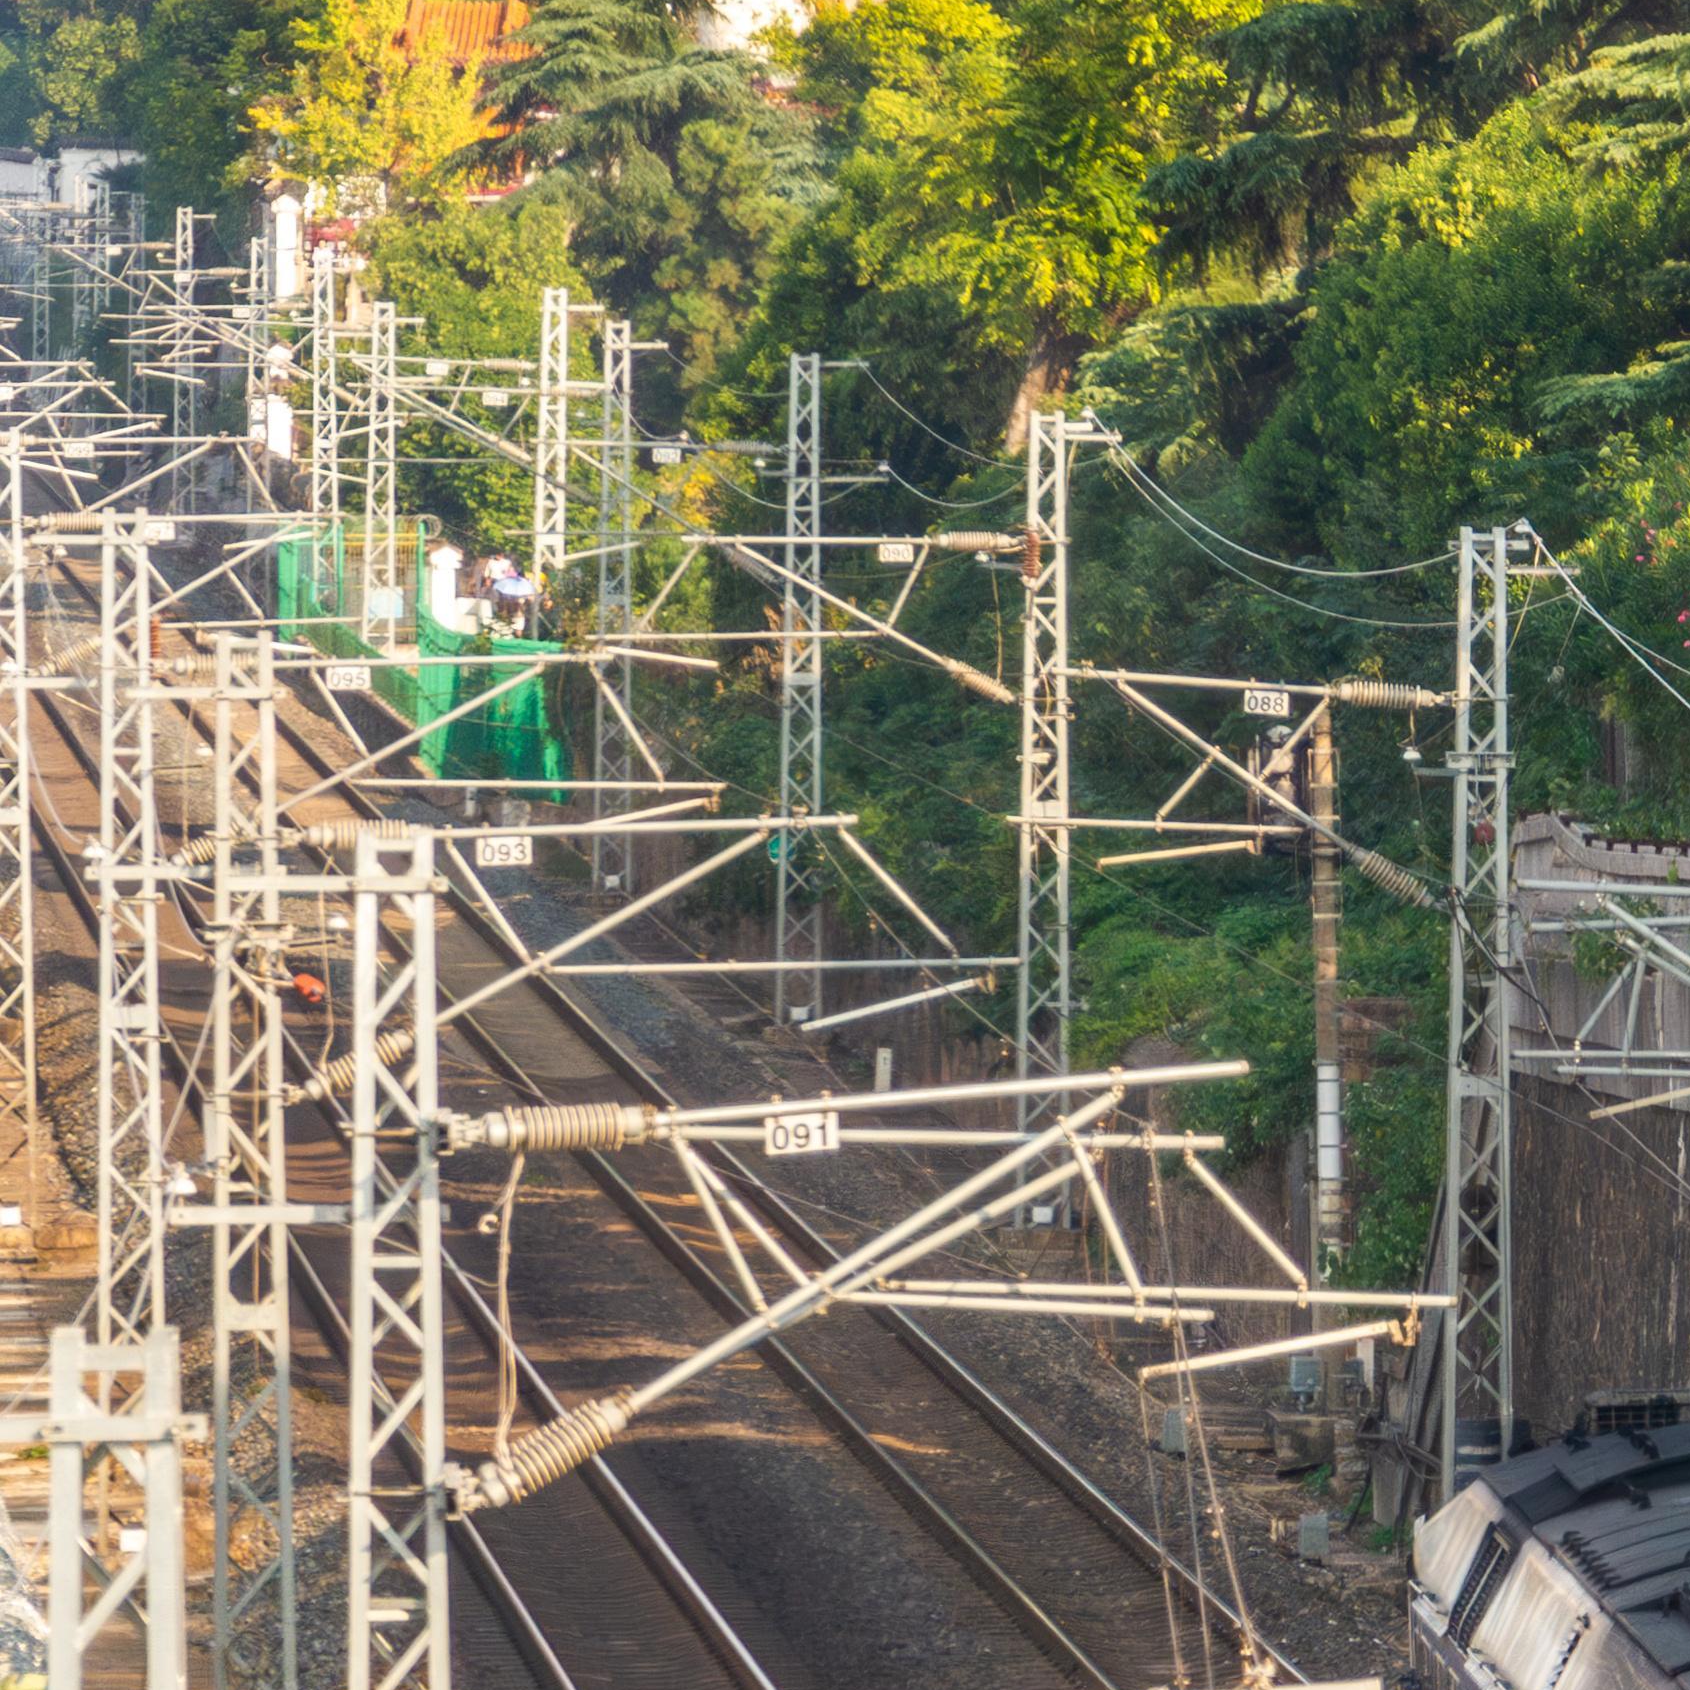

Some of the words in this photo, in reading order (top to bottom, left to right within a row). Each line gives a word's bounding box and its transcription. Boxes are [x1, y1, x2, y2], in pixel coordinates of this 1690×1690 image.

[331, 671, 366, 688] 095
[1247, 694, 1285, 713] 088
[482, 842, 527, 862] 093
[773, 1121, 829, 1150] 091
